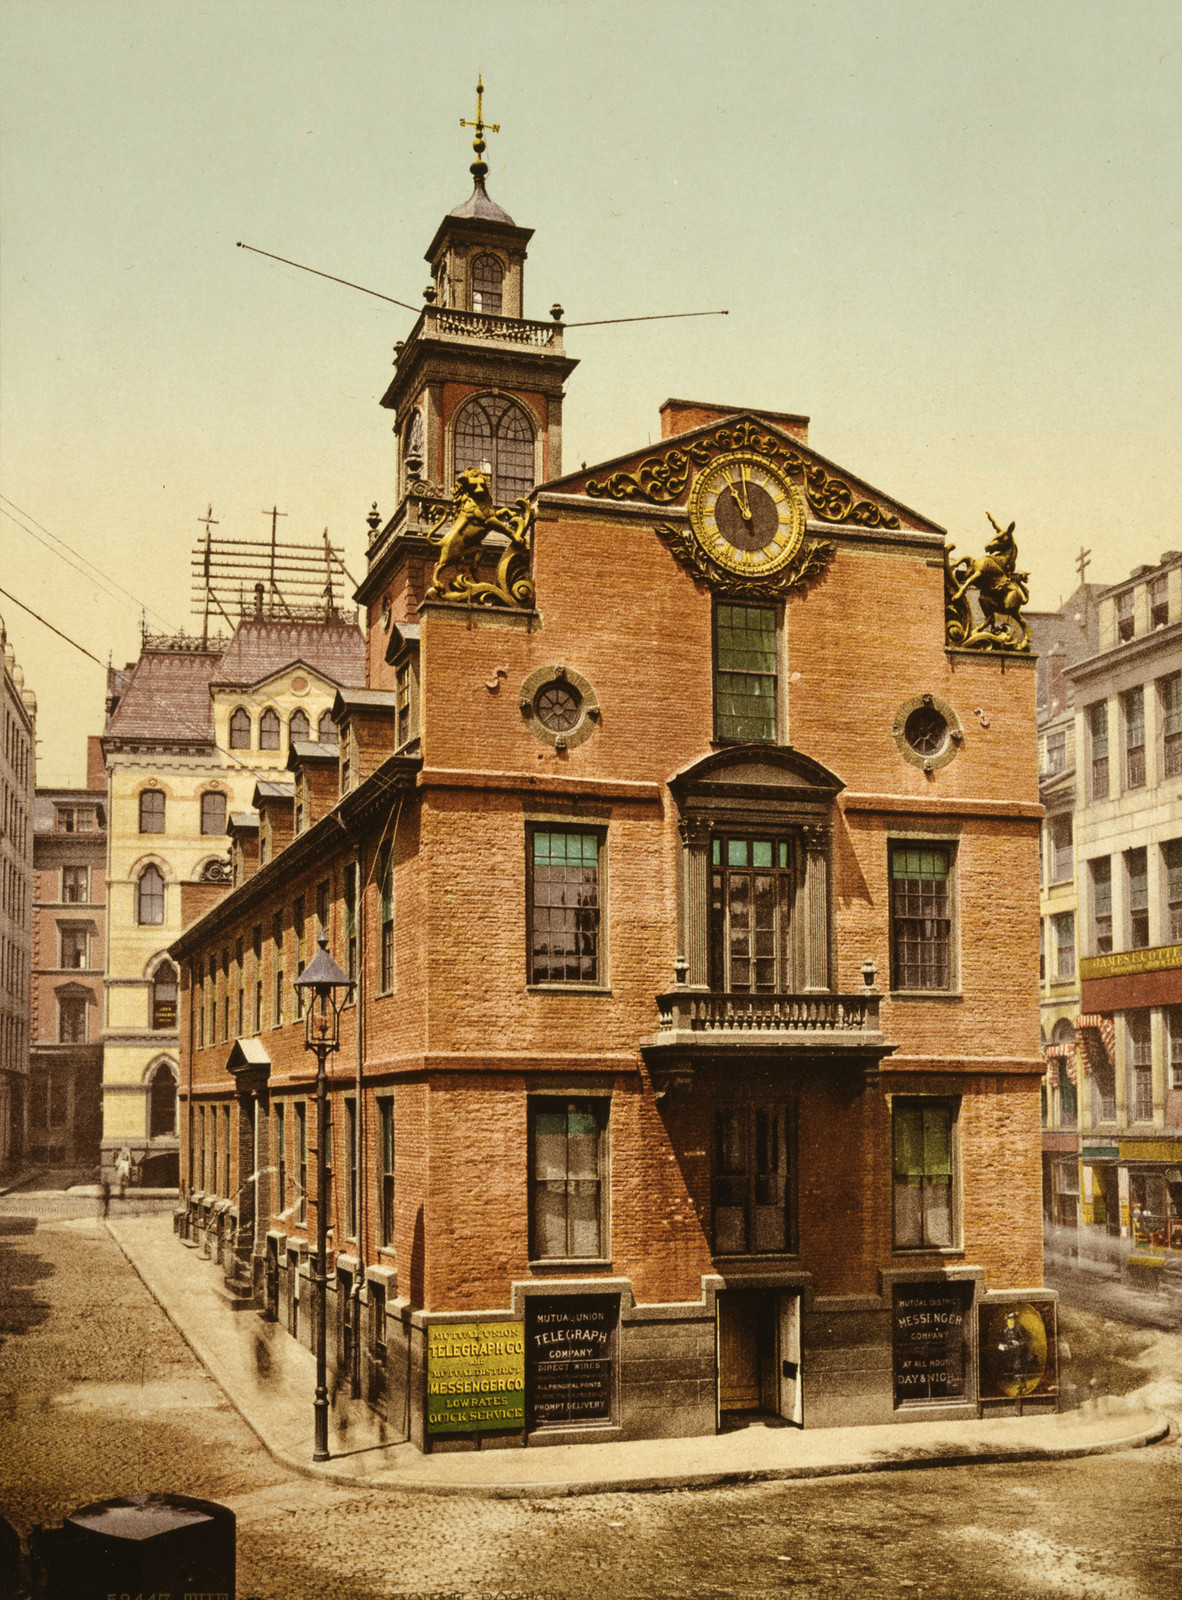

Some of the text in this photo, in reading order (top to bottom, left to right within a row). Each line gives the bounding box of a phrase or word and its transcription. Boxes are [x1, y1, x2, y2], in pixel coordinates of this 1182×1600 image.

[576, 1312, 604, 1321] UNION
[433, 1328, 518, 1341] MUTUAL UNION
[534, 1329, 608, 1346] TELEGRAPH
[911, 1331, 950, 1340] COMPANY
[429, 1341, 503, 1358] TELEGRAPH
[549, 1348, 593, 1359] COMPANY
[538, 1362, 601, 1372] DIRECT WIRES
[903, 1358, 954, 1369] AT ALL HOUR
[432, 1367, 521, 1378] MUTUAL DISTRICT
[429, 1379, 505, 1395] MESSENGER
[446, 1396, 508, 1409] LOW RATES
[534, 1400, 605, 1411] PROMPT DELIVERY
[429, 1408, 524, 1424] QUICK SERVICE
